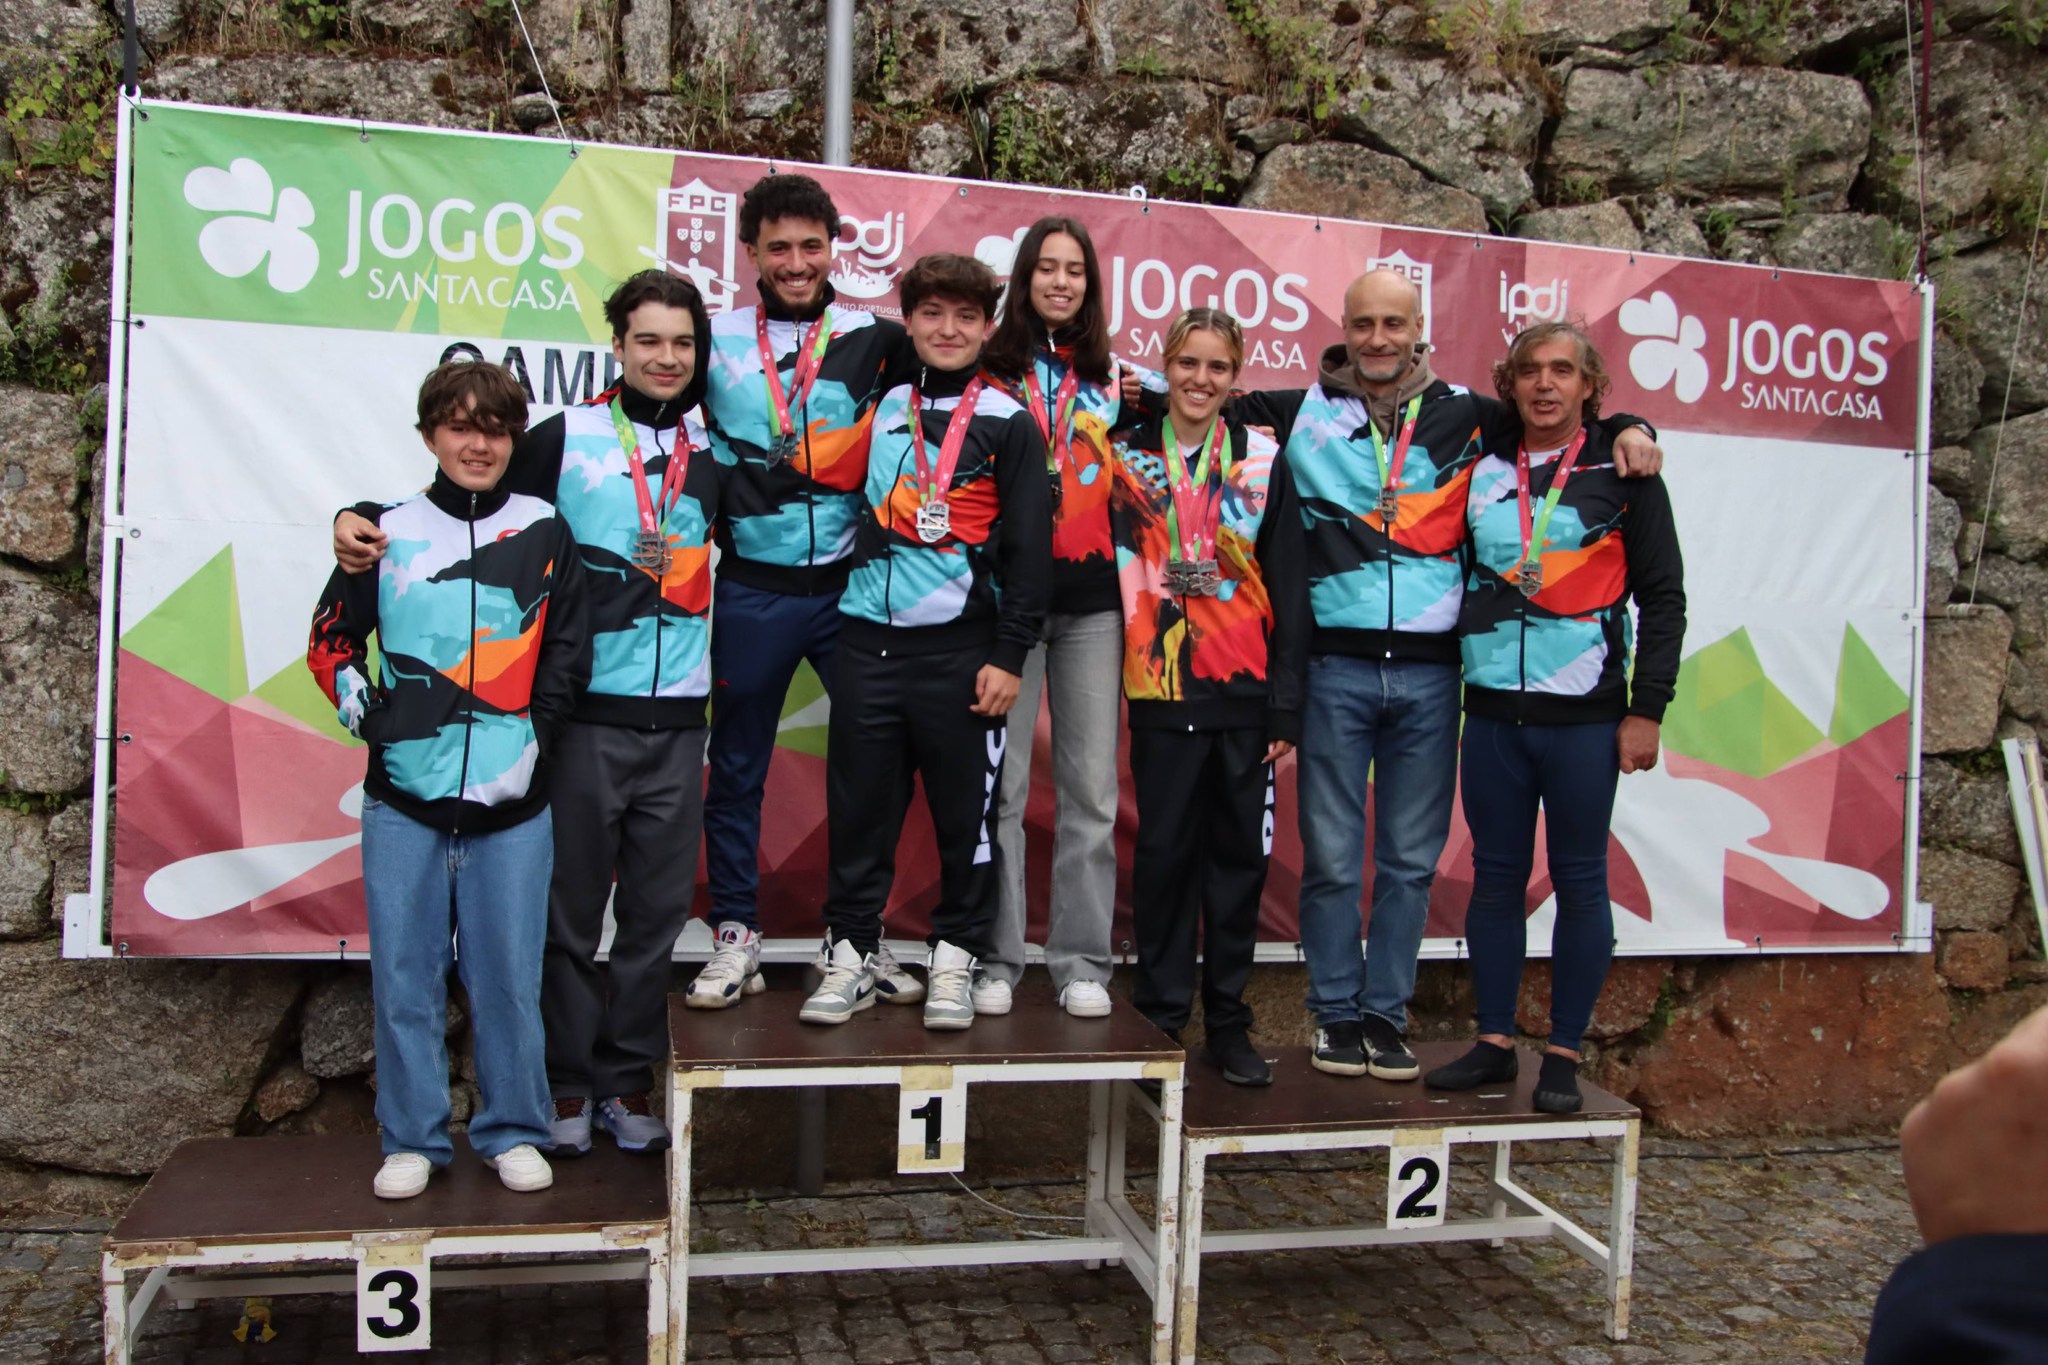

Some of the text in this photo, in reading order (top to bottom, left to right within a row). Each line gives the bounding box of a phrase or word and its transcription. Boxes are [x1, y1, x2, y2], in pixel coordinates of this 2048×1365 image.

[668, 193, 726, 212] FPC
[339, 190, 585, 279] JOGOS
[831, 211, 904, 268] pdj
[367, 268, 582, 313] SANTACASA
[1107, 256, 1310, 337] JOGOS
[1500, 270, 1568, 324] ipdj
[1720, 317, 1889, 392] JOGOS
[1740, 382, 1883, 421] SANTACASA
[911, 1096, 942, 1160] 1
[1395, 1157, 1440, 1219] 2
[366, 1270, 421, 1339] 3
